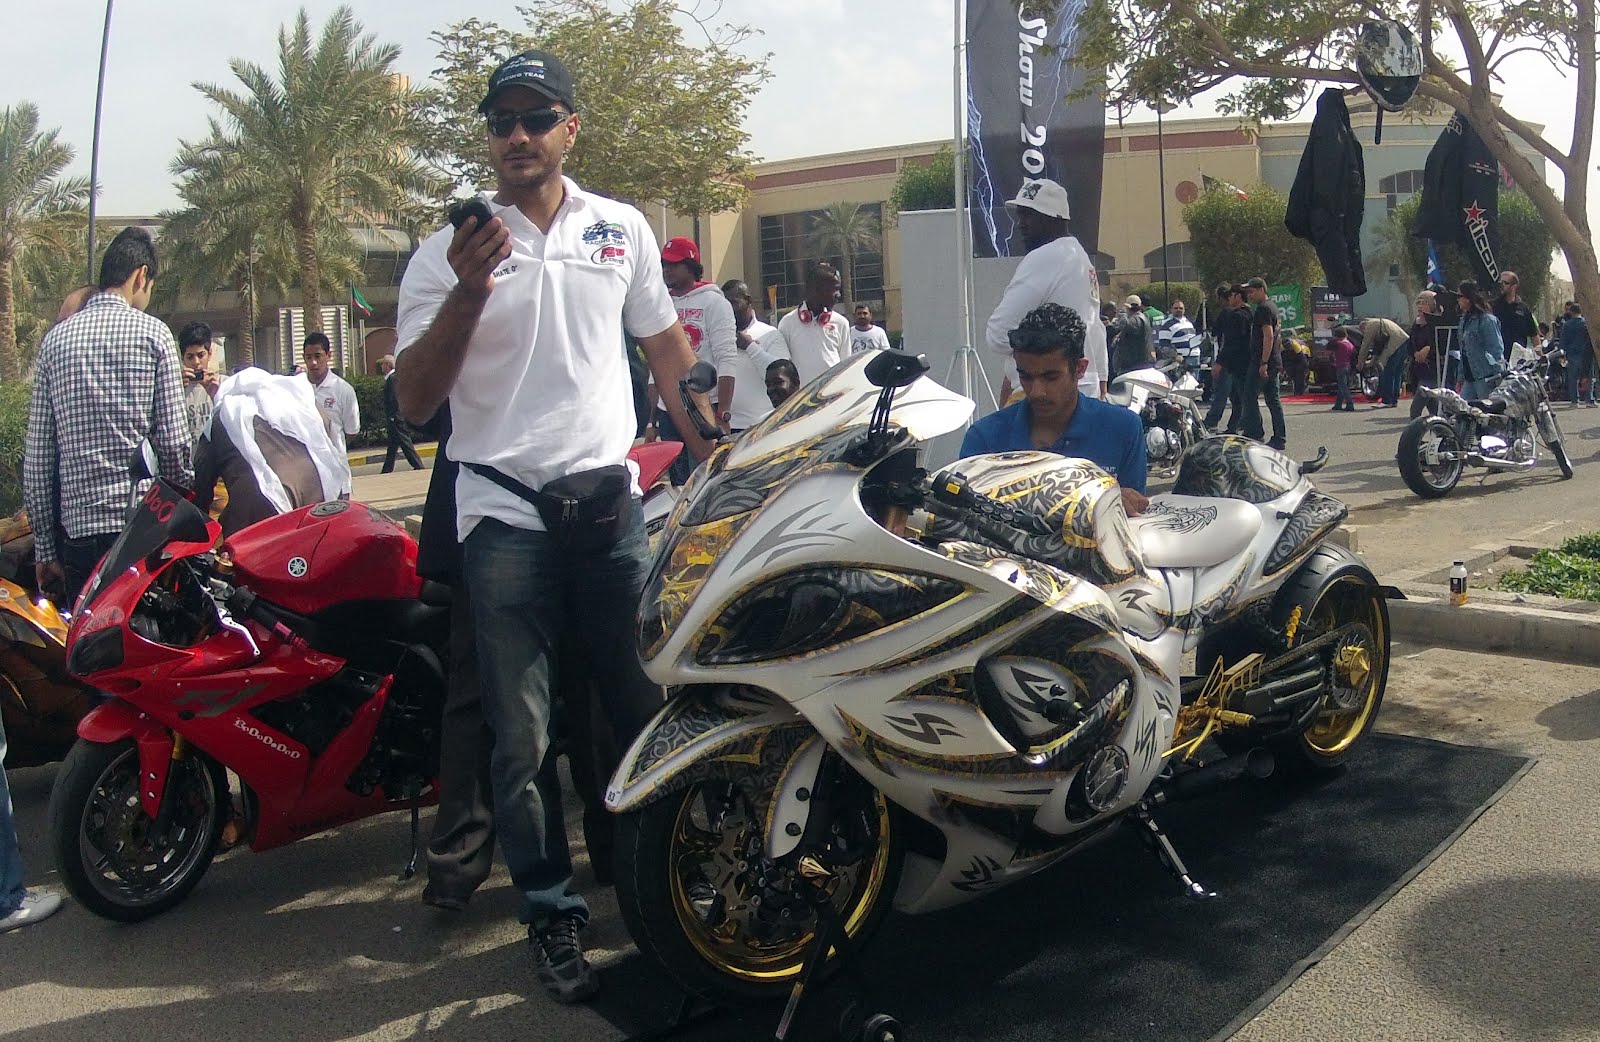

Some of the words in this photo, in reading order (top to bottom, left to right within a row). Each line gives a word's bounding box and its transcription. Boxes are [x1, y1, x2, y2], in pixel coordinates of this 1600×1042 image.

[523, 71, 545, 80] TEAM
[1018, 1, 1048, 107] Show
[1020, 121, 1047, 175] 20
